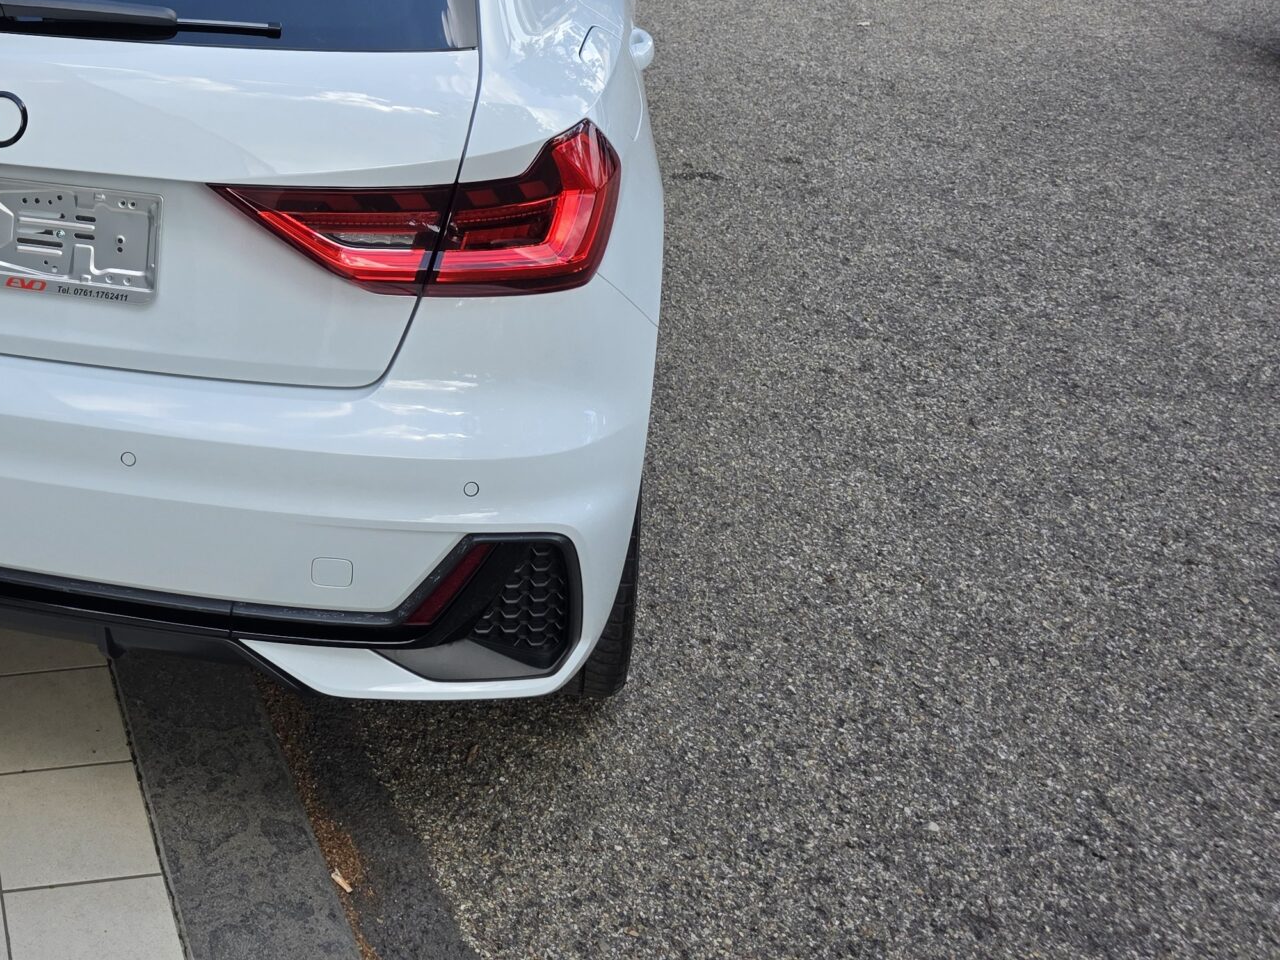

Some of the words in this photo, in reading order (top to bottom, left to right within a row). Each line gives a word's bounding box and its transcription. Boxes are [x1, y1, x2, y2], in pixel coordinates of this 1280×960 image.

[5, 276, 47, 292] EVO
[57, 285, 71, 296] Tel.
[73, 287, 129, 302] 0761.1762411
